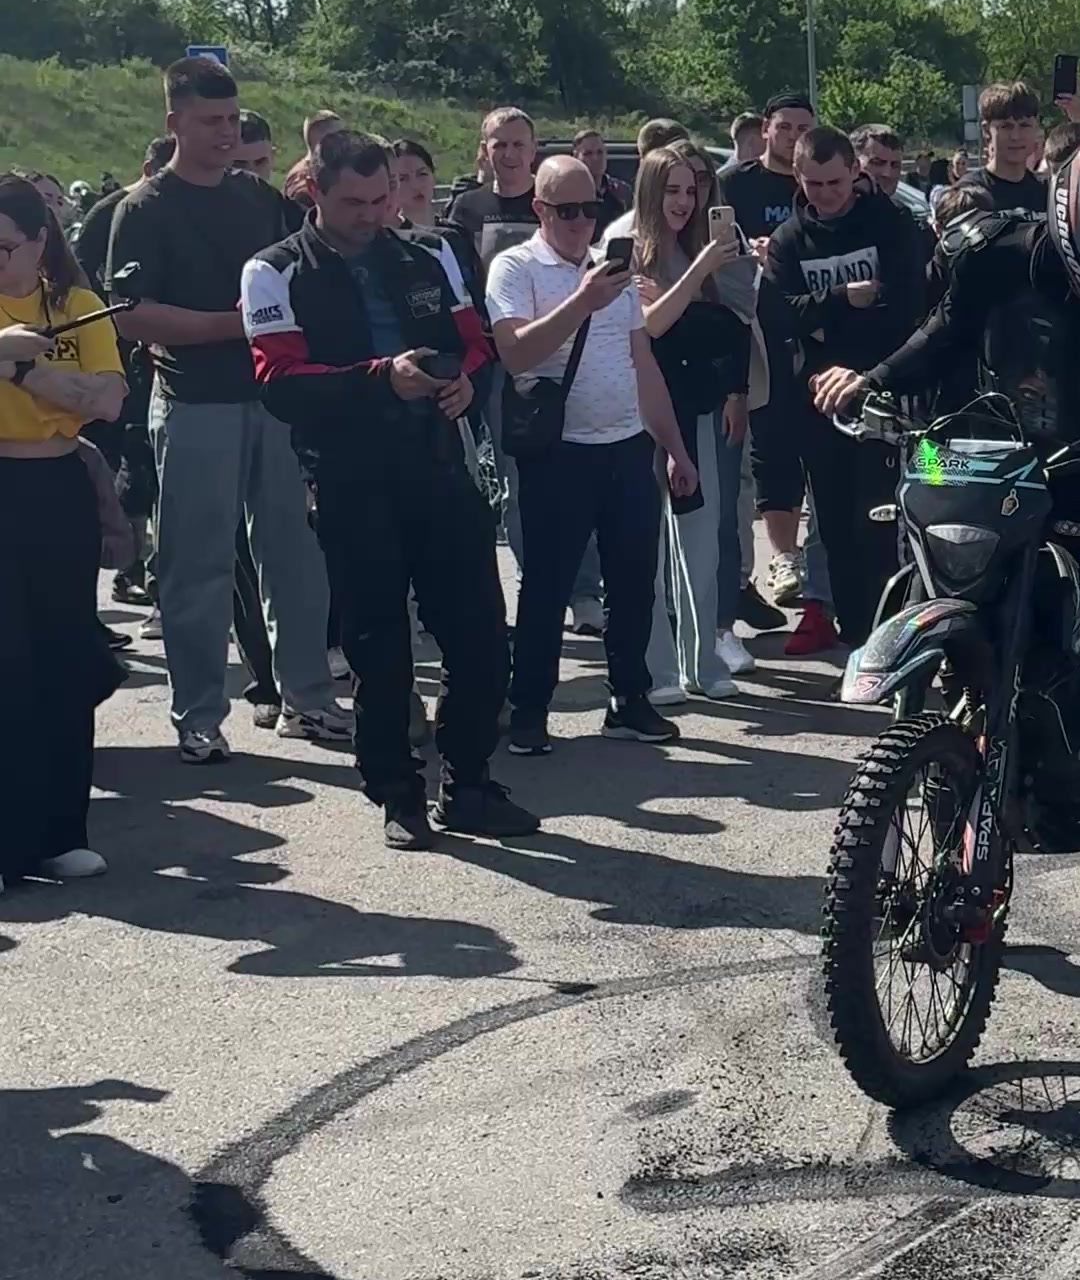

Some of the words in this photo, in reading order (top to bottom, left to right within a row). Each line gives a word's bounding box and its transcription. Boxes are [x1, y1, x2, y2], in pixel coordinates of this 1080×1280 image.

[765, 206, 792, 221] MA
[807, 260, 873, 293] BRAND
[916, 458, 971, 470] SPARK
[976, 799, 995, 862] SPAR
